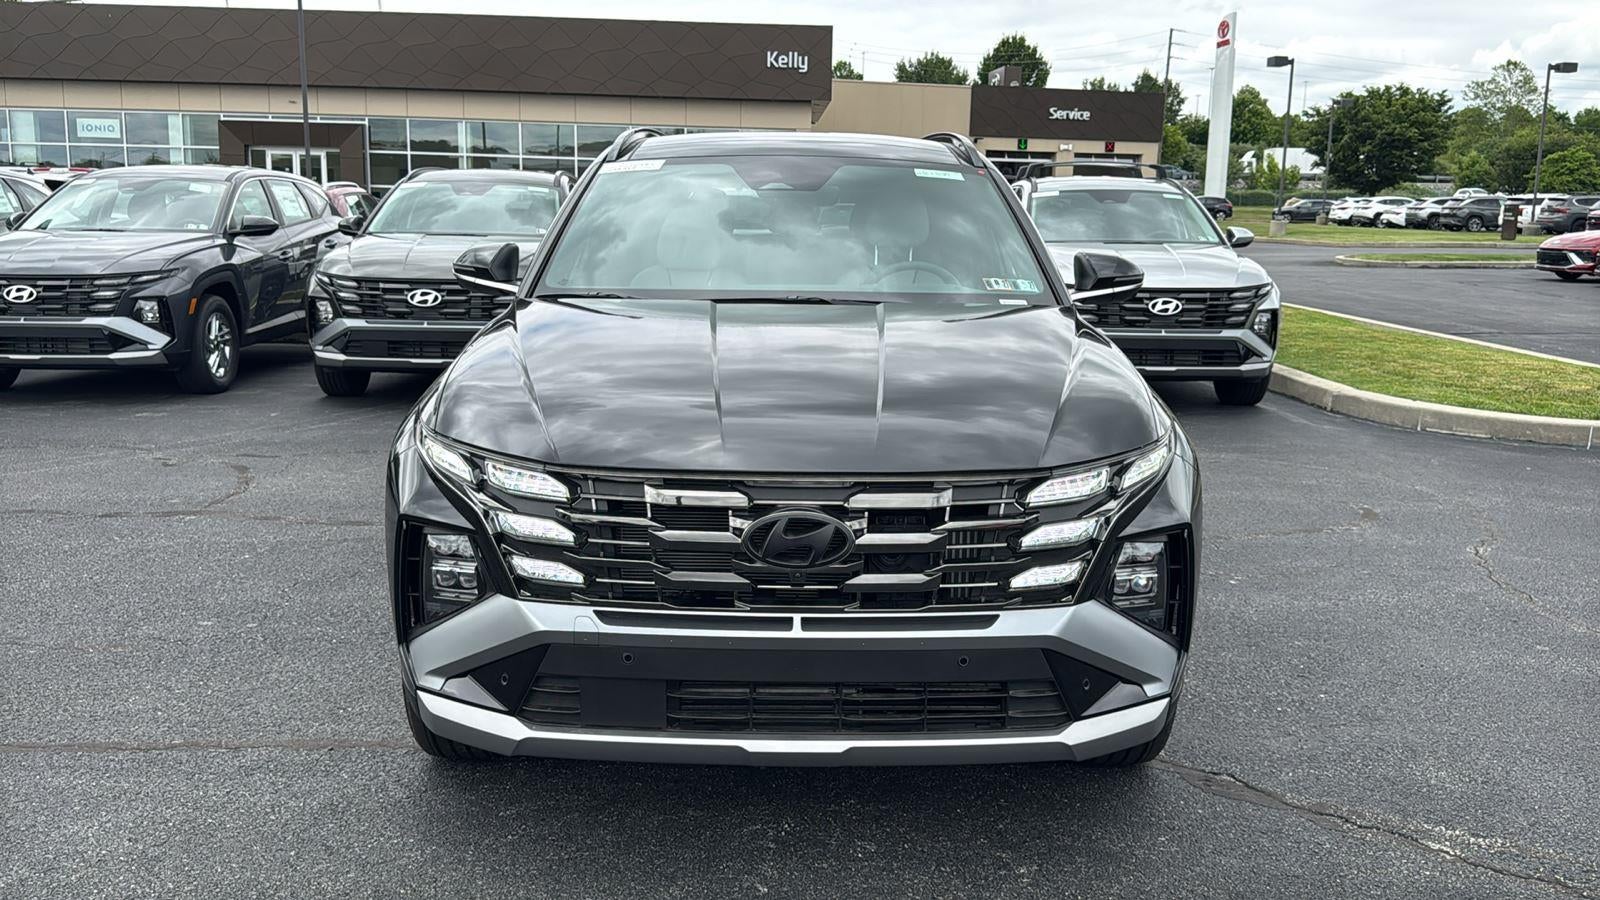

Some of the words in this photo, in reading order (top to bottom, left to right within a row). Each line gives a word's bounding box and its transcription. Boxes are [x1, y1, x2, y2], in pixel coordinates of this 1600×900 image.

[766, 50, 808, 73] Kelly
[1048, 106, 1091, 121] Service
[81, 124, 115, 132] IONIQ
